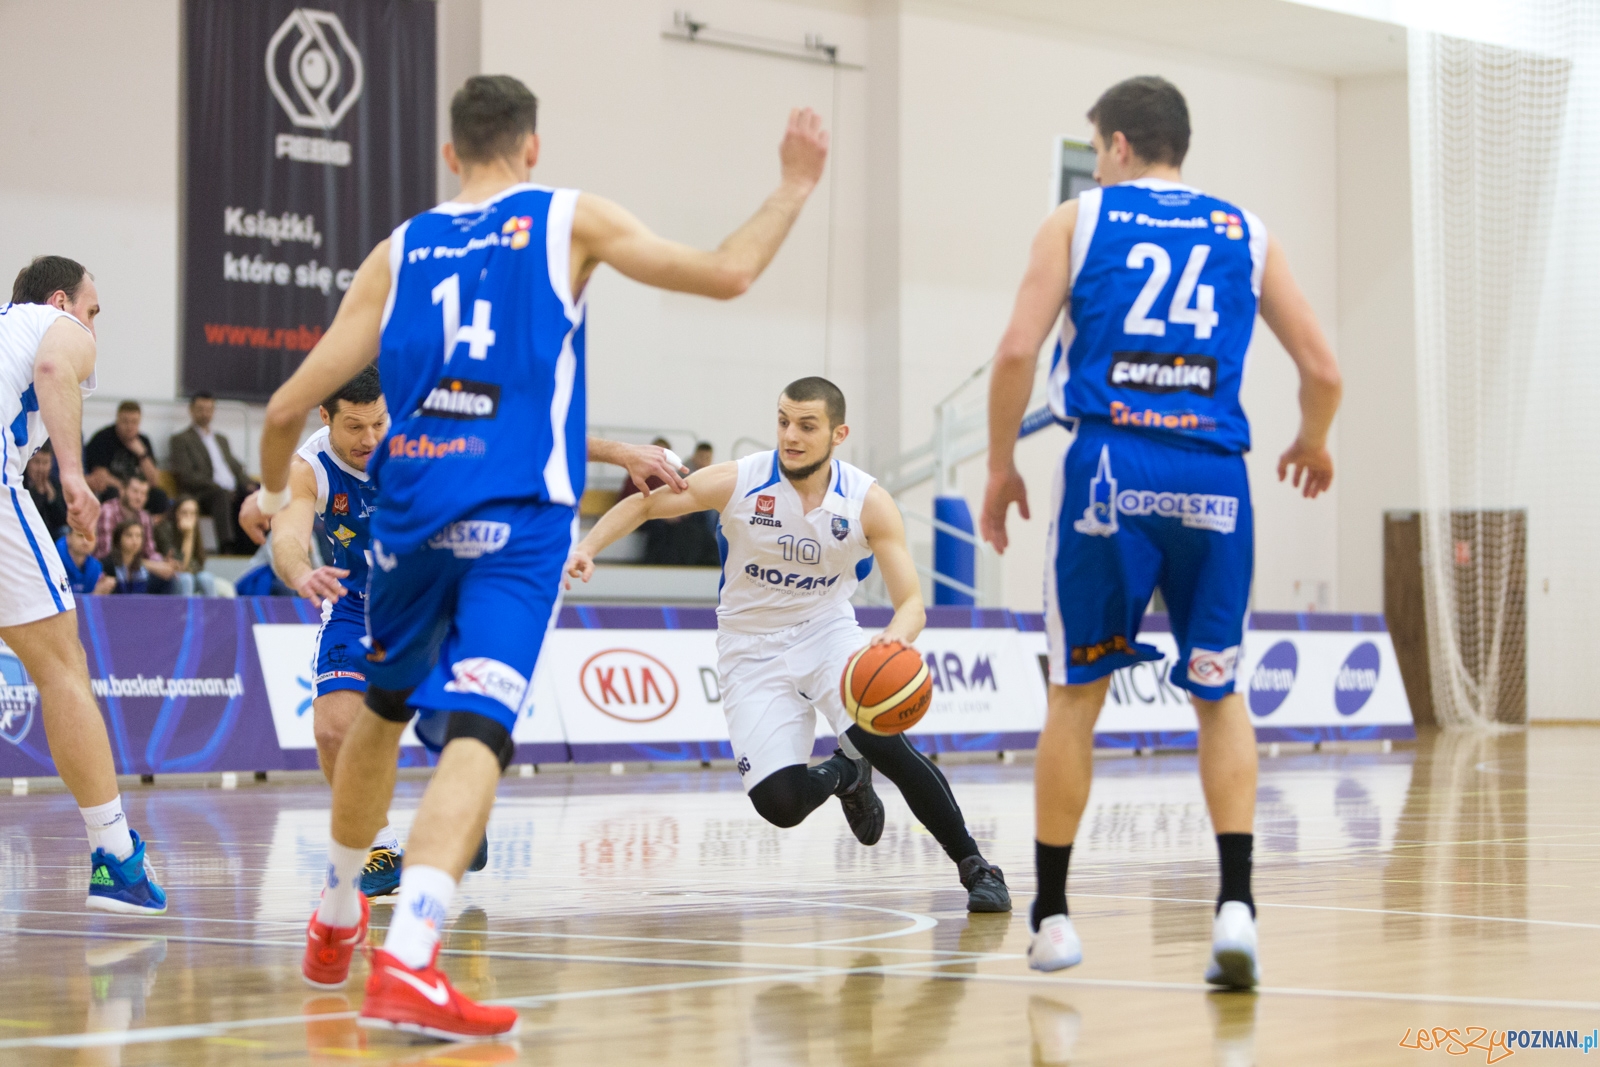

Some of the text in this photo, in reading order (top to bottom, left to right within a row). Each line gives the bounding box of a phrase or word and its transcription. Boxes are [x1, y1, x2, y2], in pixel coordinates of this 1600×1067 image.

[431, 272, 496, 365] 14
[1123, 242, 1219, 339] 24
[777, 534, 821, 565] 10
[595, 666, 666, 705] KIA
